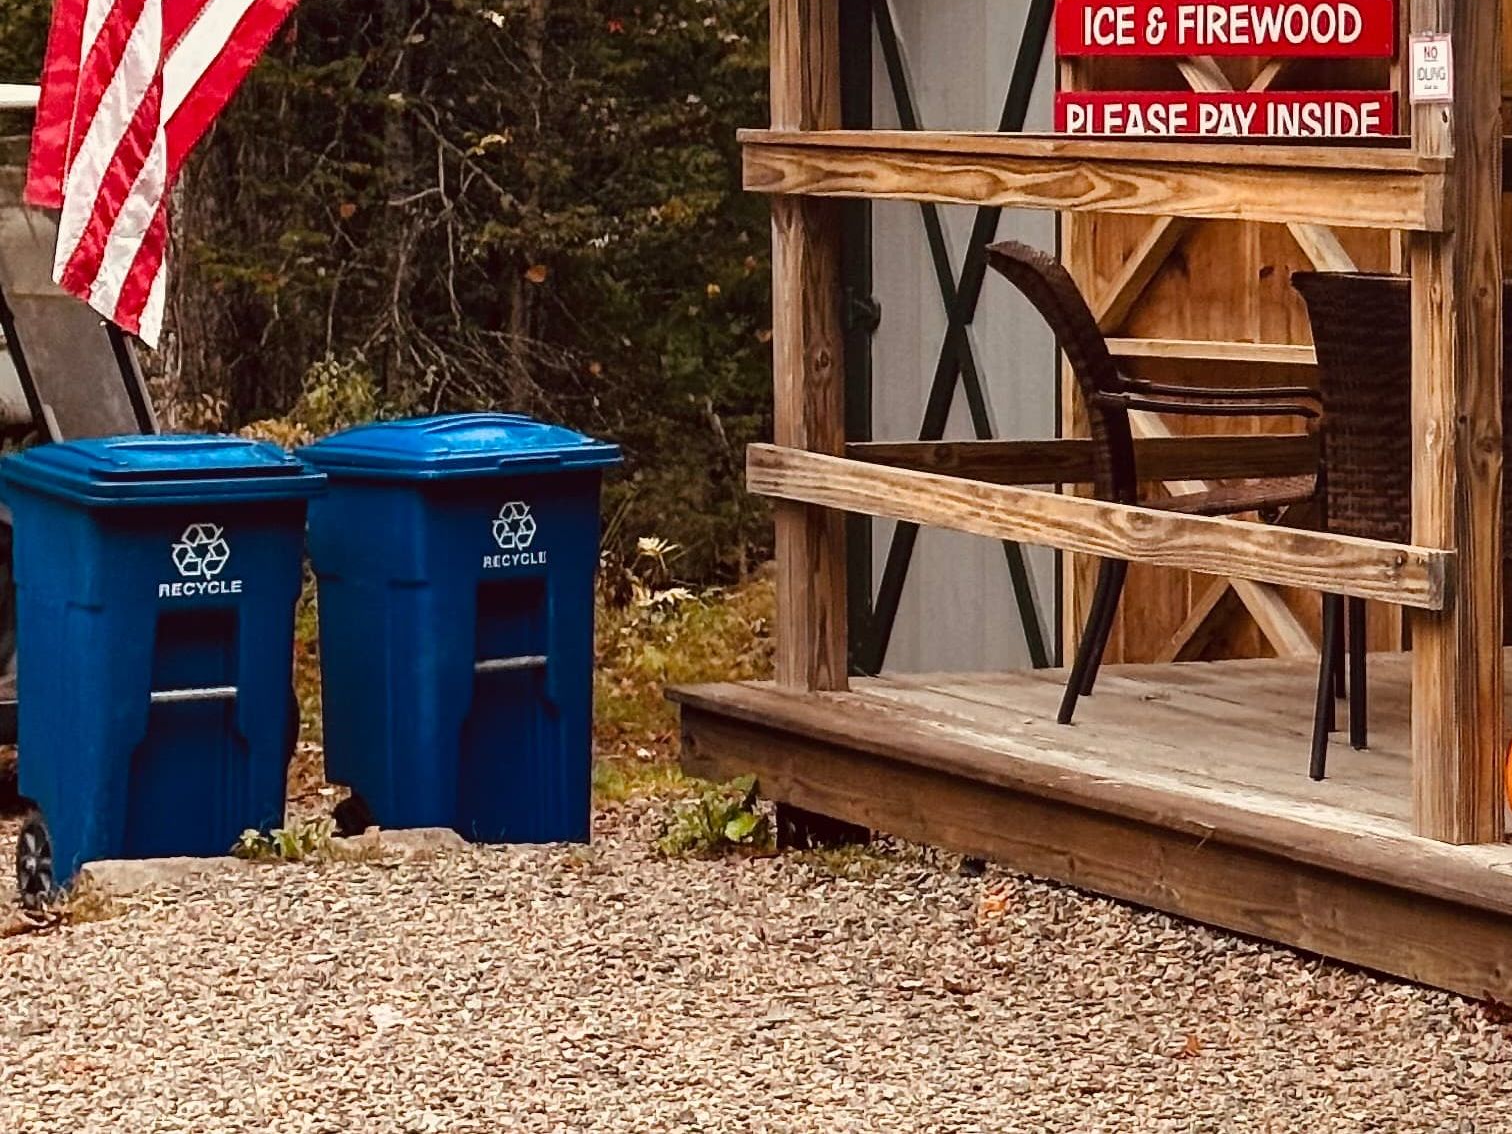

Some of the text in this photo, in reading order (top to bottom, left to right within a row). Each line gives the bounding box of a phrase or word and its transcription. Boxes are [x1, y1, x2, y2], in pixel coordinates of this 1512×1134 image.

[1084, 2, 1363, 46] ICE & FIREWOOD
[1424, 46, 1438, 59] NO
[1066, 101, 1381, 136] PLEASE PAY INSIDE
[483, 551, 547, 568] RECYCLE
[158, 579, 243, 598] RECYCLE
